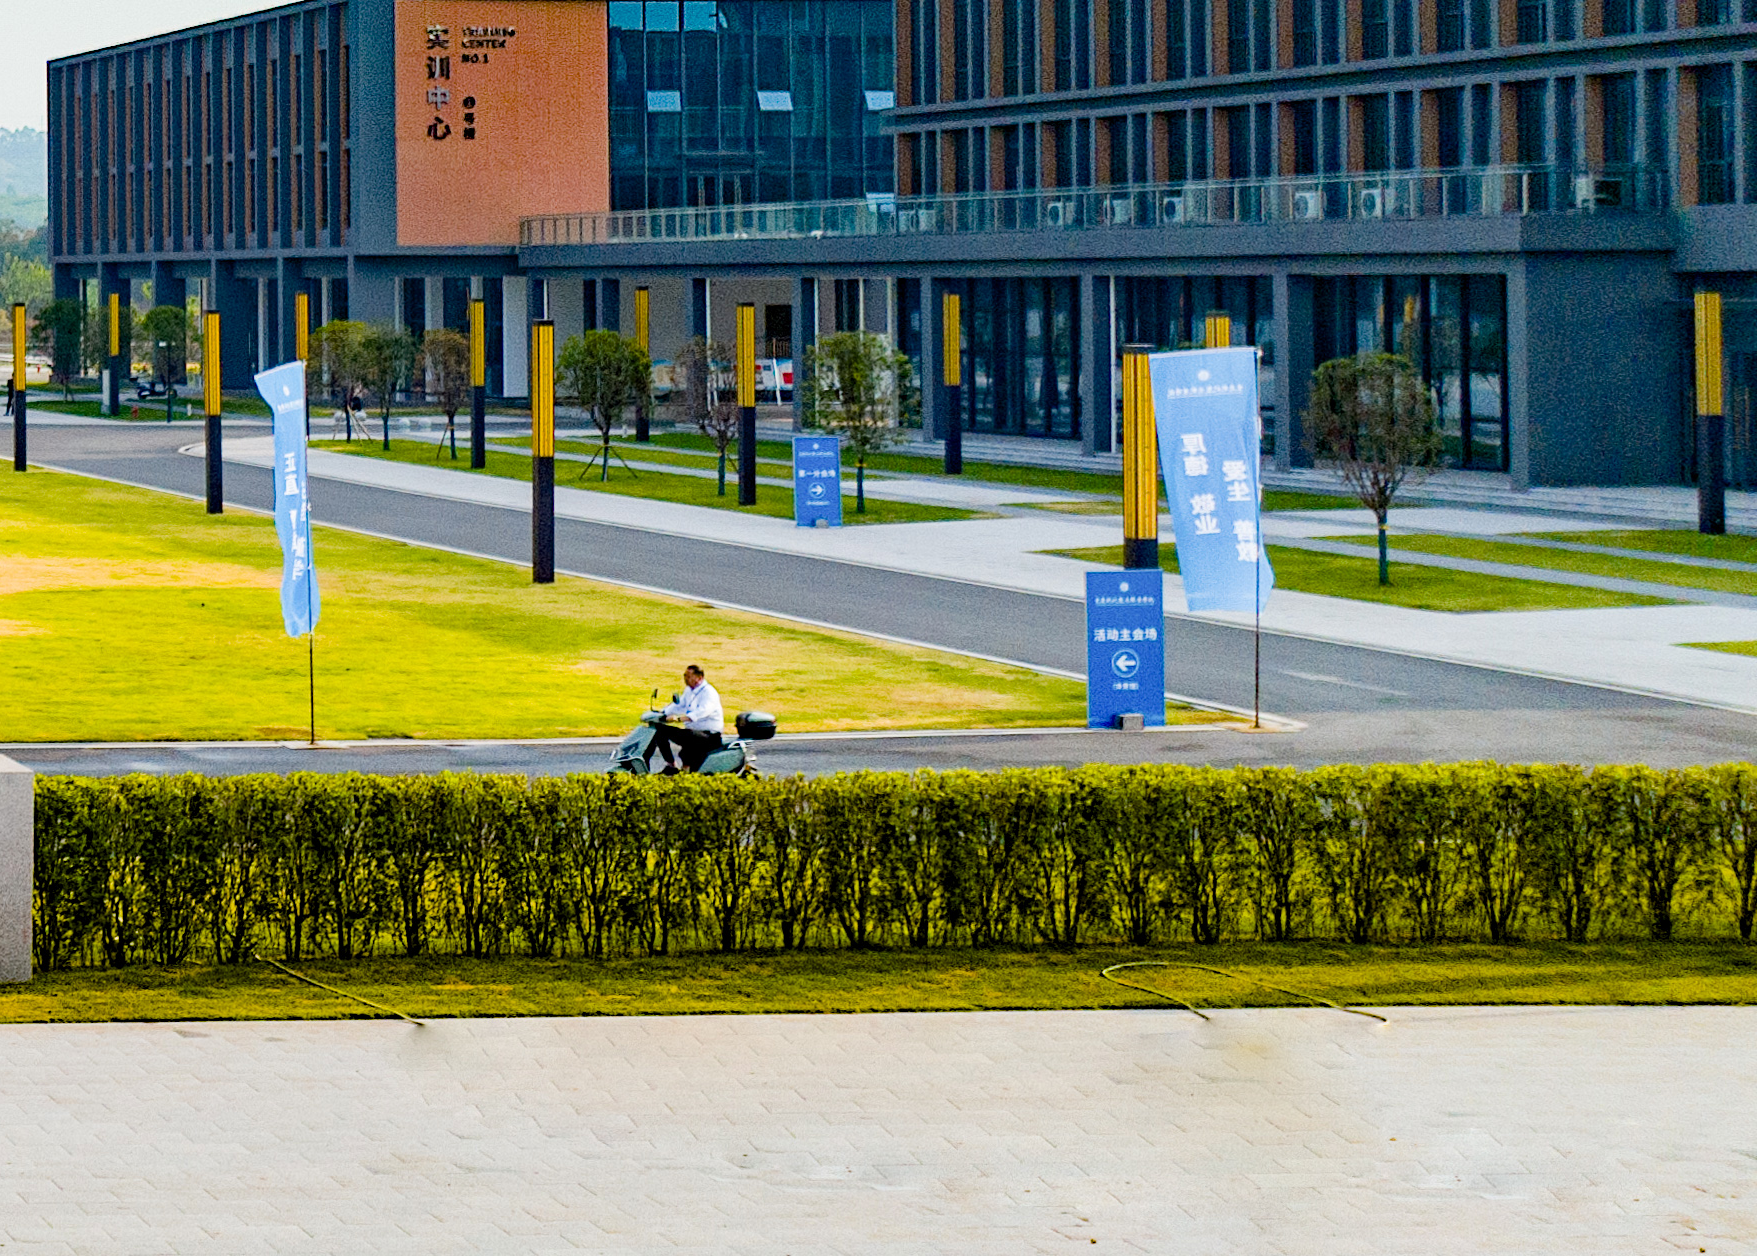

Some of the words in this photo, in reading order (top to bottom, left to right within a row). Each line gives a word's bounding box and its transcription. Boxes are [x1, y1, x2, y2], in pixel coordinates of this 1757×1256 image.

[461, 38, 507, 49] CENTER
[425, 24, 452, 141] 实训中心
[1093, 627, 1158, 642] 活动主会场
